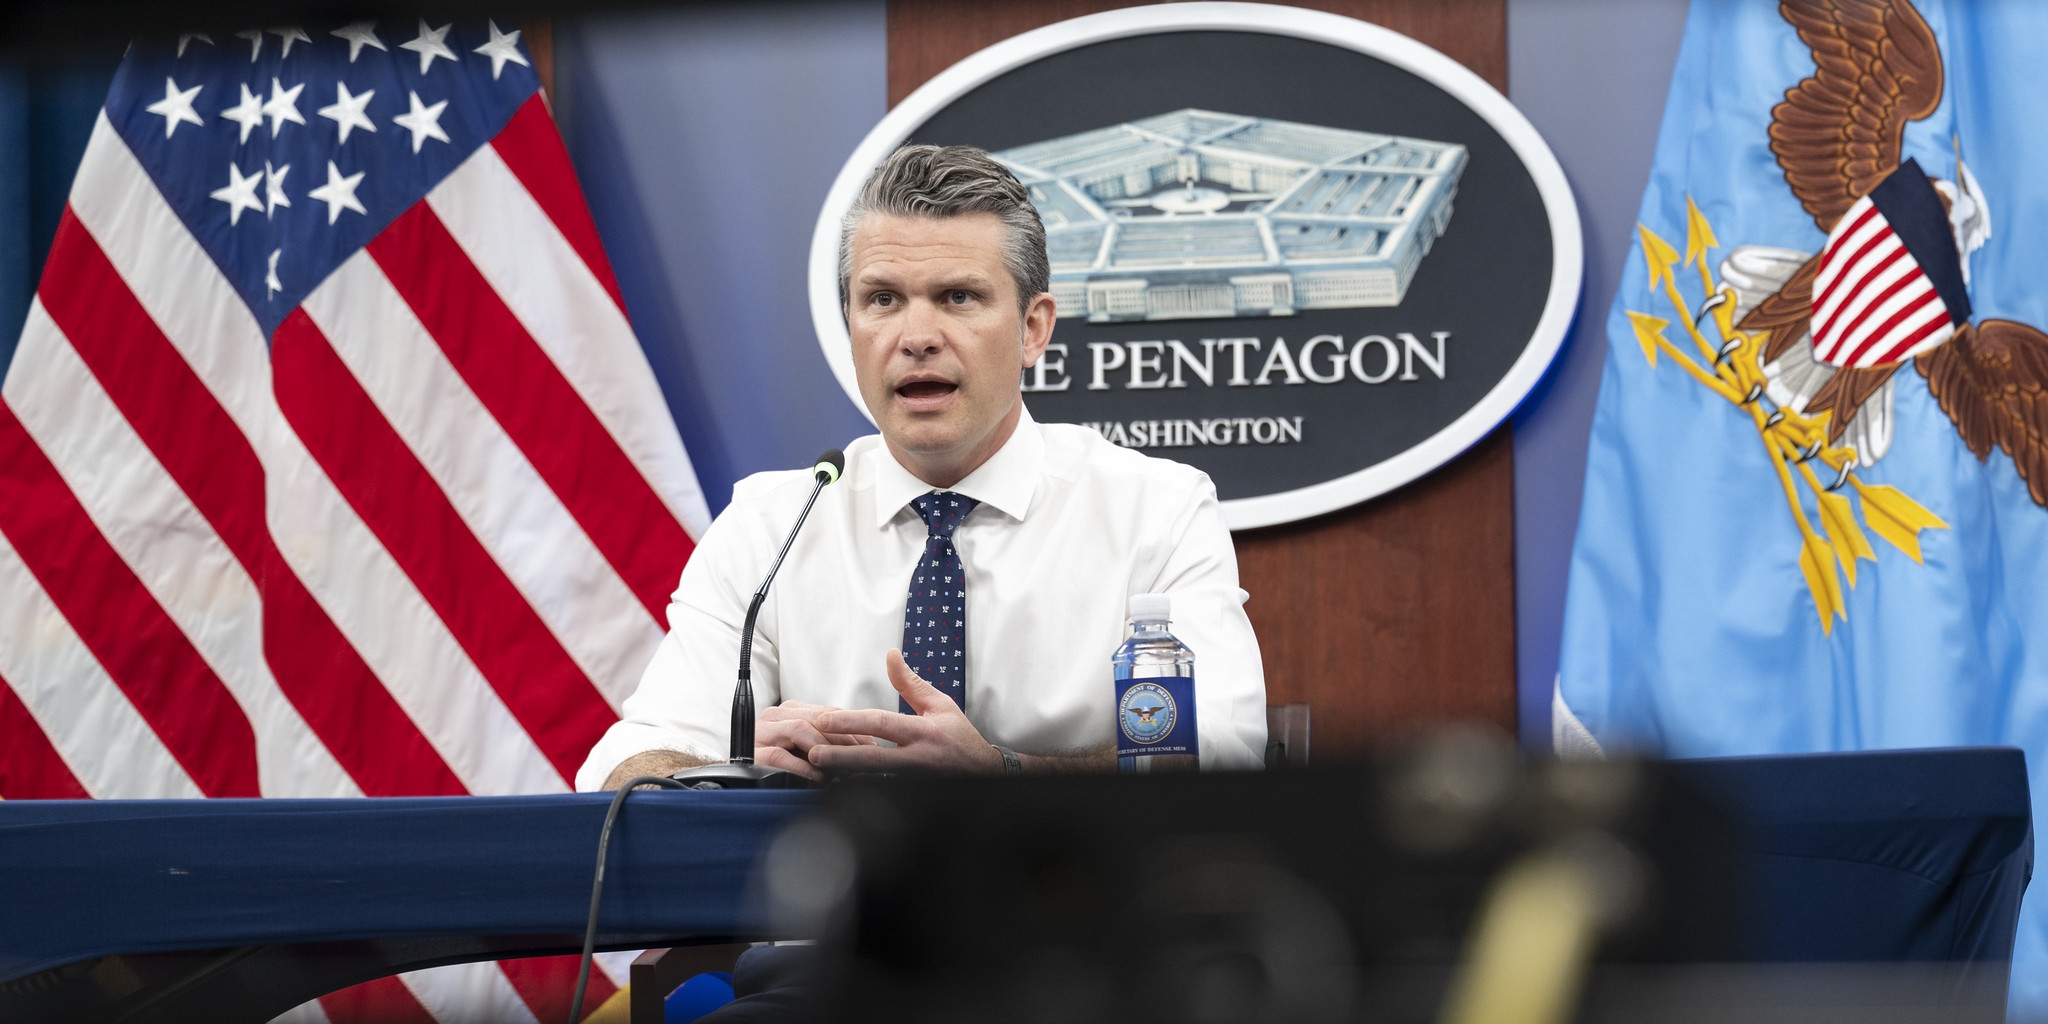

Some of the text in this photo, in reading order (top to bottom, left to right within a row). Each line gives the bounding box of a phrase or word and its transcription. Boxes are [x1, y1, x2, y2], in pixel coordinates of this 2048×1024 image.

[1087, 331, 1451, 391] PENTAGON
[1121, 685, 1145, 715] DEPARTMENT
[1157, 688, 1174, 711] DEFENSE
